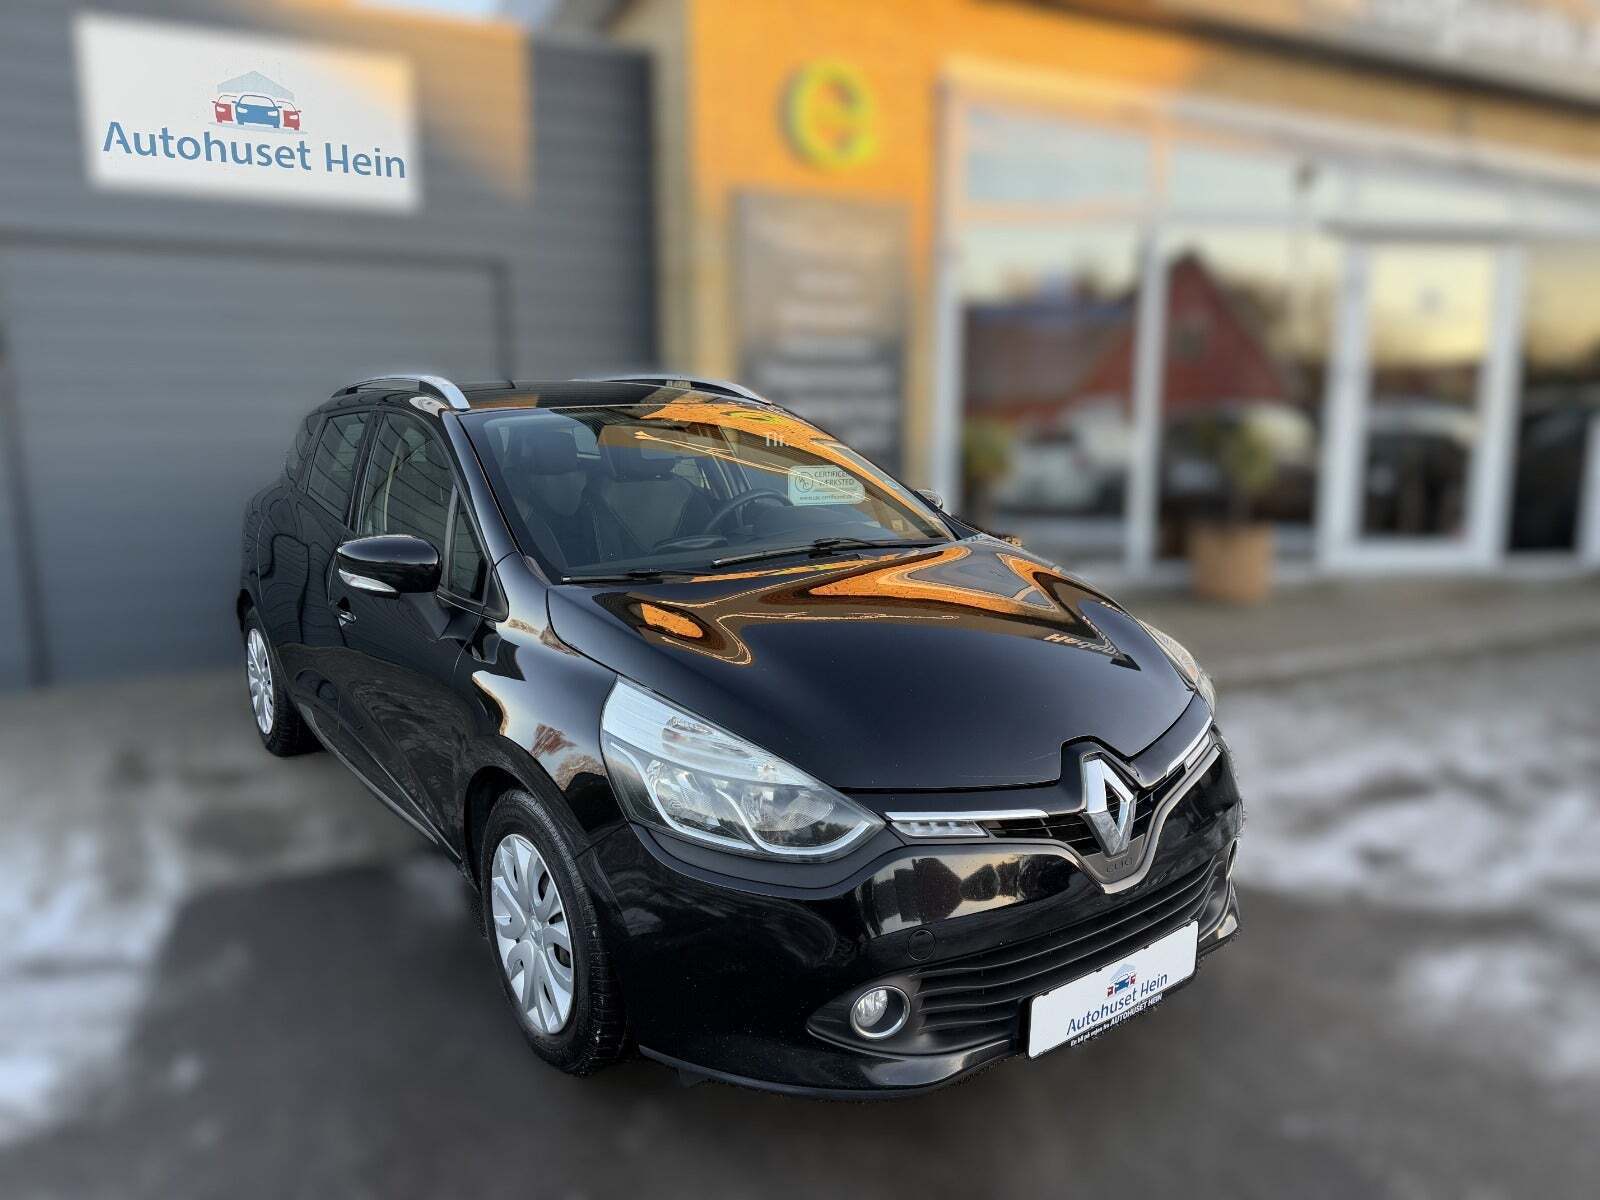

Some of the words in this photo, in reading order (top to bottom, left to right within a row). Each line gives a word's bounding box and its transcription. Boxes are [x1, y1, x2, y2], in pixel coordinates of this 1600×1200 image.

[102, 121, 312, 171] Autohuset
[324, 142, 406, 179] Hein
[1066, 987, 1137, 1036] Autohuset
[1140, 973, 1168, 997] Hein
[1109, 1001, 1147, 1027] AUTOHUSET
[1147, 992, 1163, 1006] HEIN
